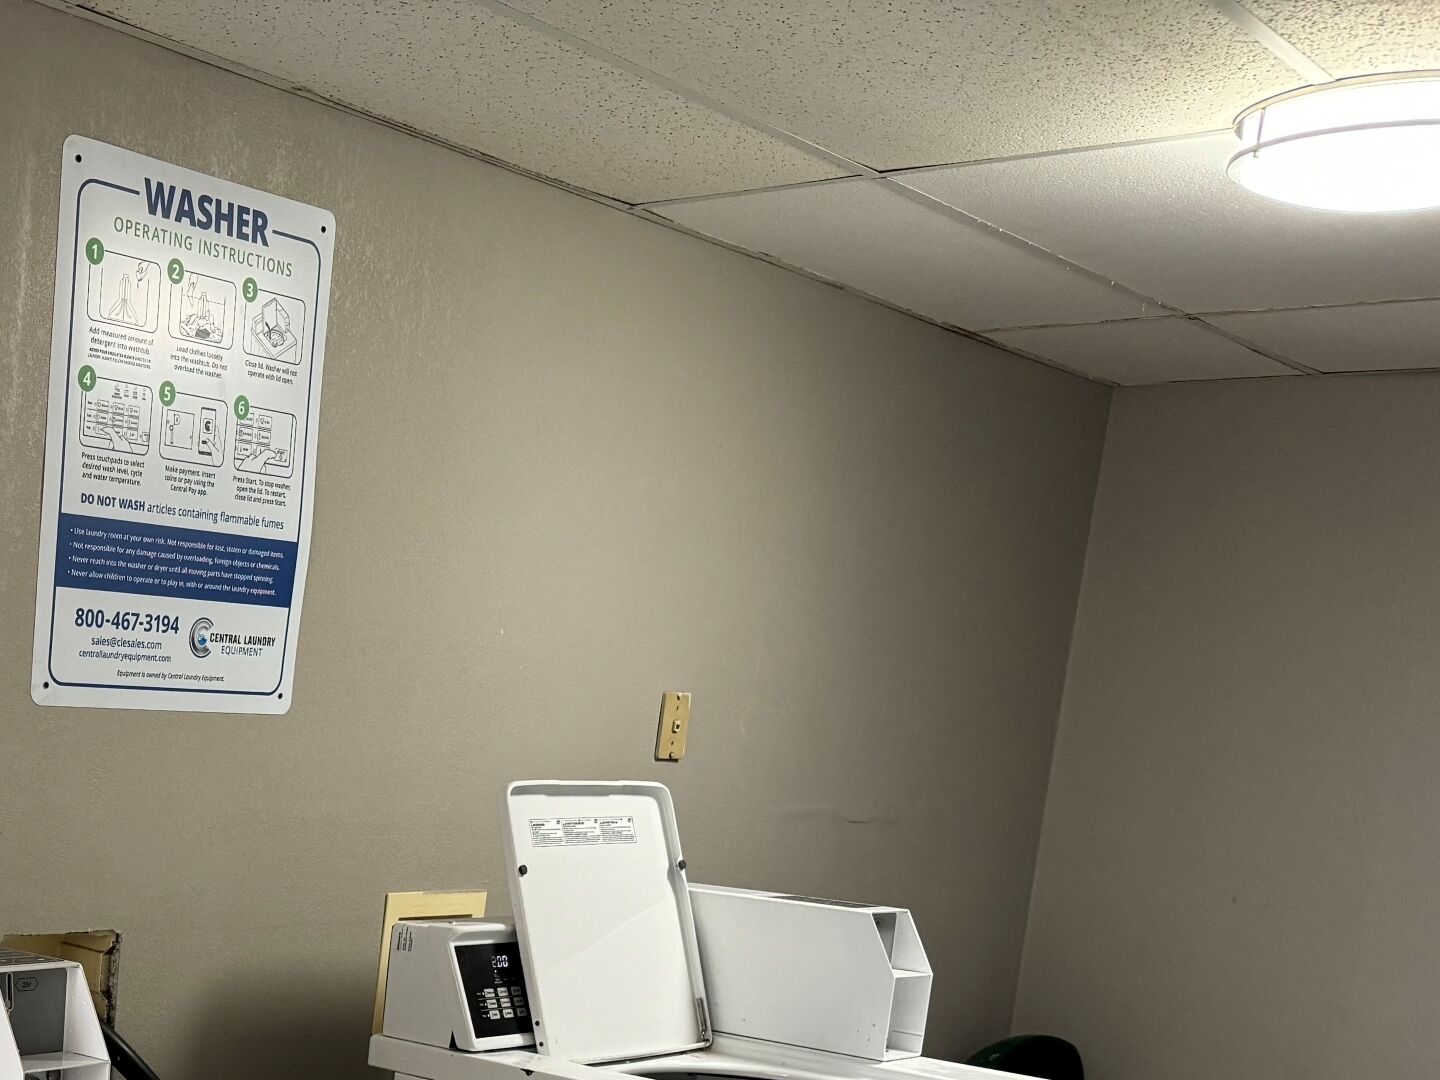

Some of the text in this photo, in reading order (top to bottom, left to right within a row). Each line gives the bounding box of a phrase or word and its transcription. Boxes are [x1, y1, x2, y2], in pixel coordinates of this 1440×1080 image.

[144, 177, 270, 247] WASHER
[91, 244, 98, 260] 1
[114, 216, 292, 277] OPERATING INSTRUCTIONS
[172, 263, 180, 280] 2
[246, 283, 254, 297] 3
[82, 370, 92, 386] 4
[163, 386, 171, 402] 5
[238, 401, 245, 415] 6
[80, 492, 284, 530] DO NOT WASH articles containing flammable fumes
[75, 608, 179, 634] 800-467-3194
[91, 636, 162, 650] sales@clesales.com
[210, 633, 276, 646] CENTRAL LAUNDRY
[78, 650, 171, 663] centrallaundryequipment.com
[221, 645, 263, 656] EQUIPMENT
